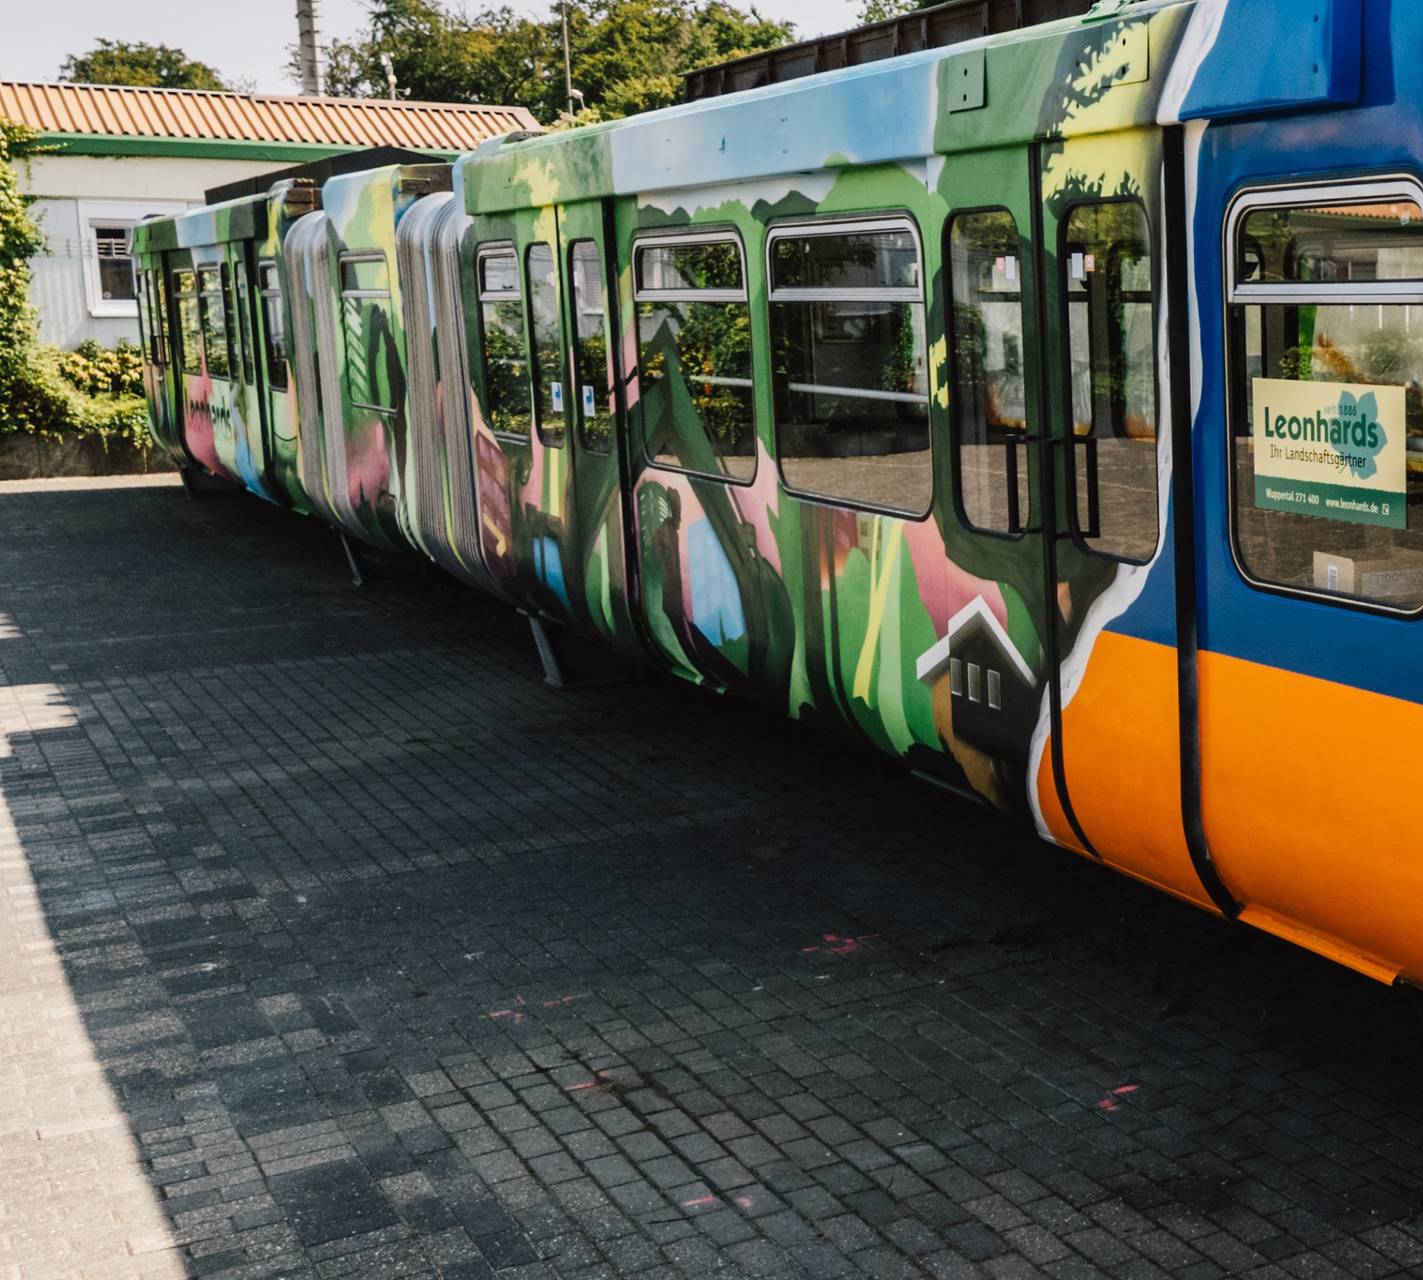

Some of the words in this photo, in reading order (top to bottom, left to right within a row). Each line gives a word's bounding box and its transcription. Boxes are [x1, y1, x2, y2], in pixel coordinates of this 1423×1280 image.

[1264, 406, 1379, 449] Leonhards
[1270, 443, 1282, 458] Ihr
[1285, 446, 1367, 469] Landschaftsgärtner
[1265, 487, 1294, 502] Wuppertal
[1295, 491, 1307, 504] 271
[1308, 493, 1320, 505] 400
[1325, 497, 1379, 514] www.leonhards.de
